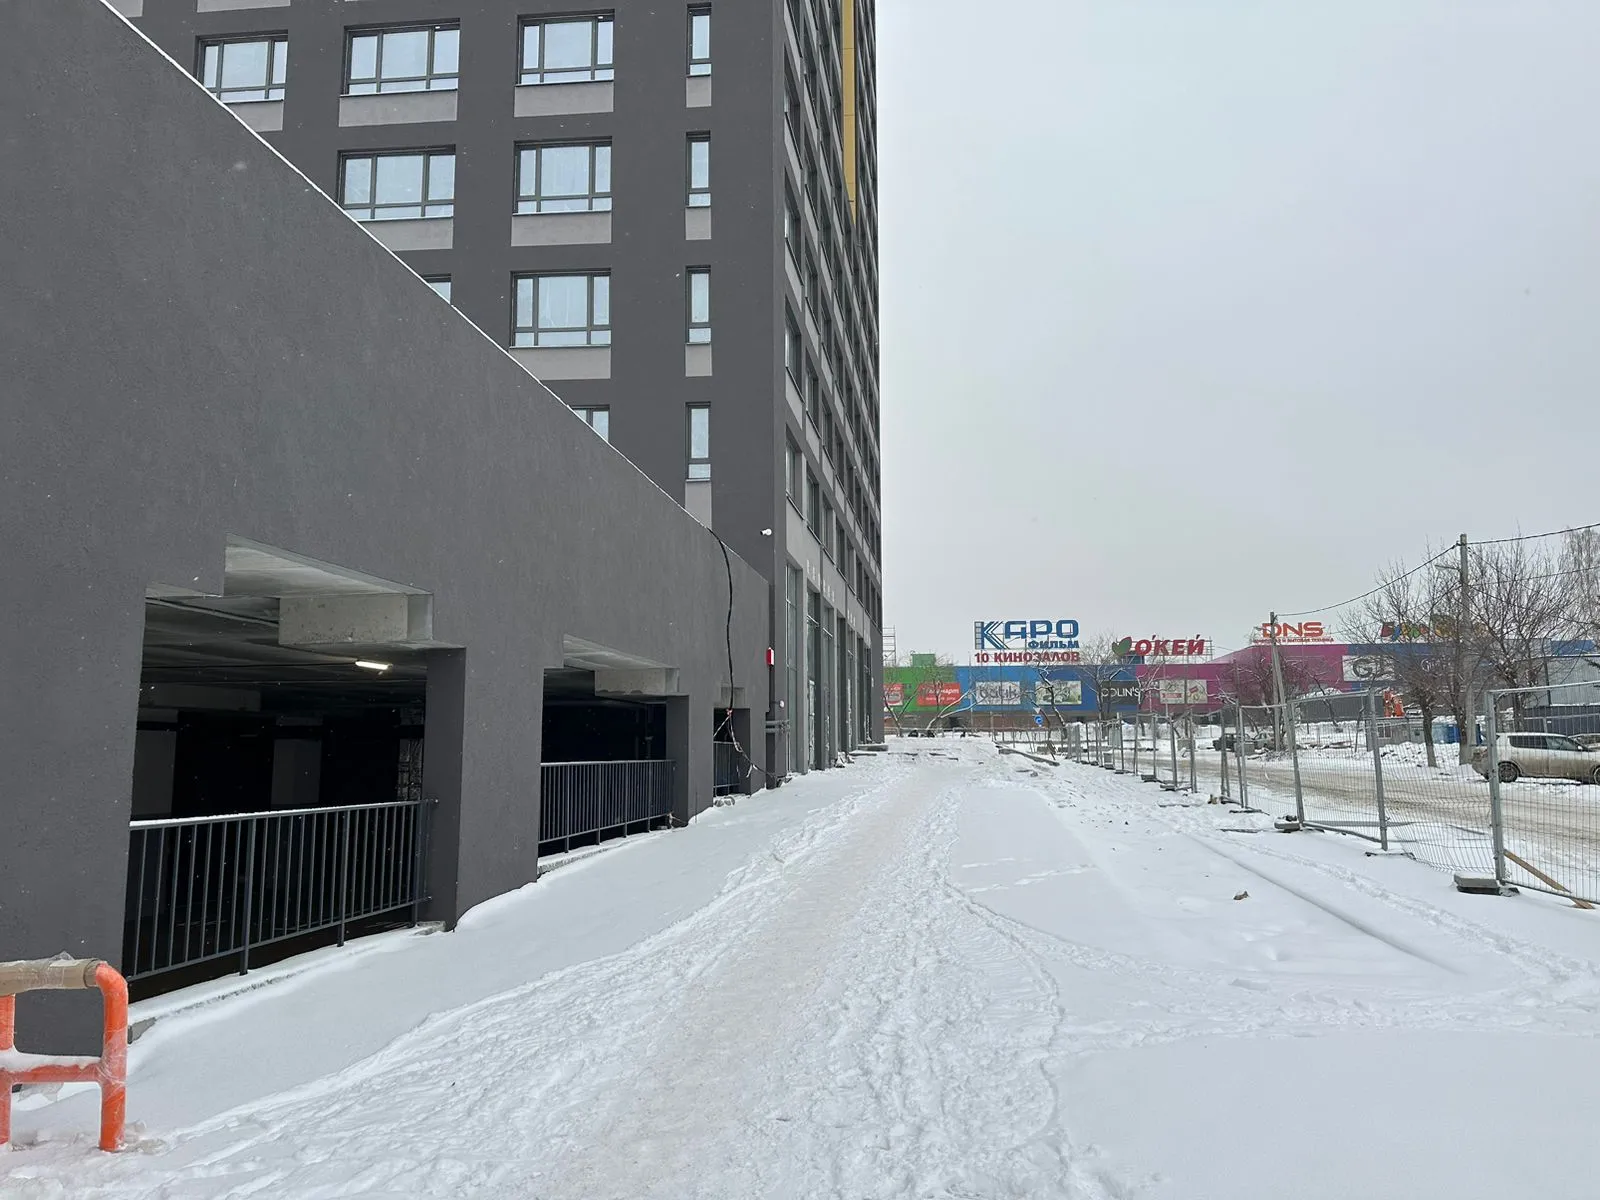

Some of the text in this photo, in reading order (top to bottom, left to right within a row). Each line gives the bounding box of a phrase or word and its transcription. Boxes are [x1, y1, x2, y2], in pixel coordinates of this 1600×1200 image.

[974, 619, 1080, 650] КАРО
[1261, 621, 1324, 638] DNS
[974, 651, 1081, 663] 10 КИНОЗАЛОВ
[1101, 686, 1140, 697] COLIN'S
